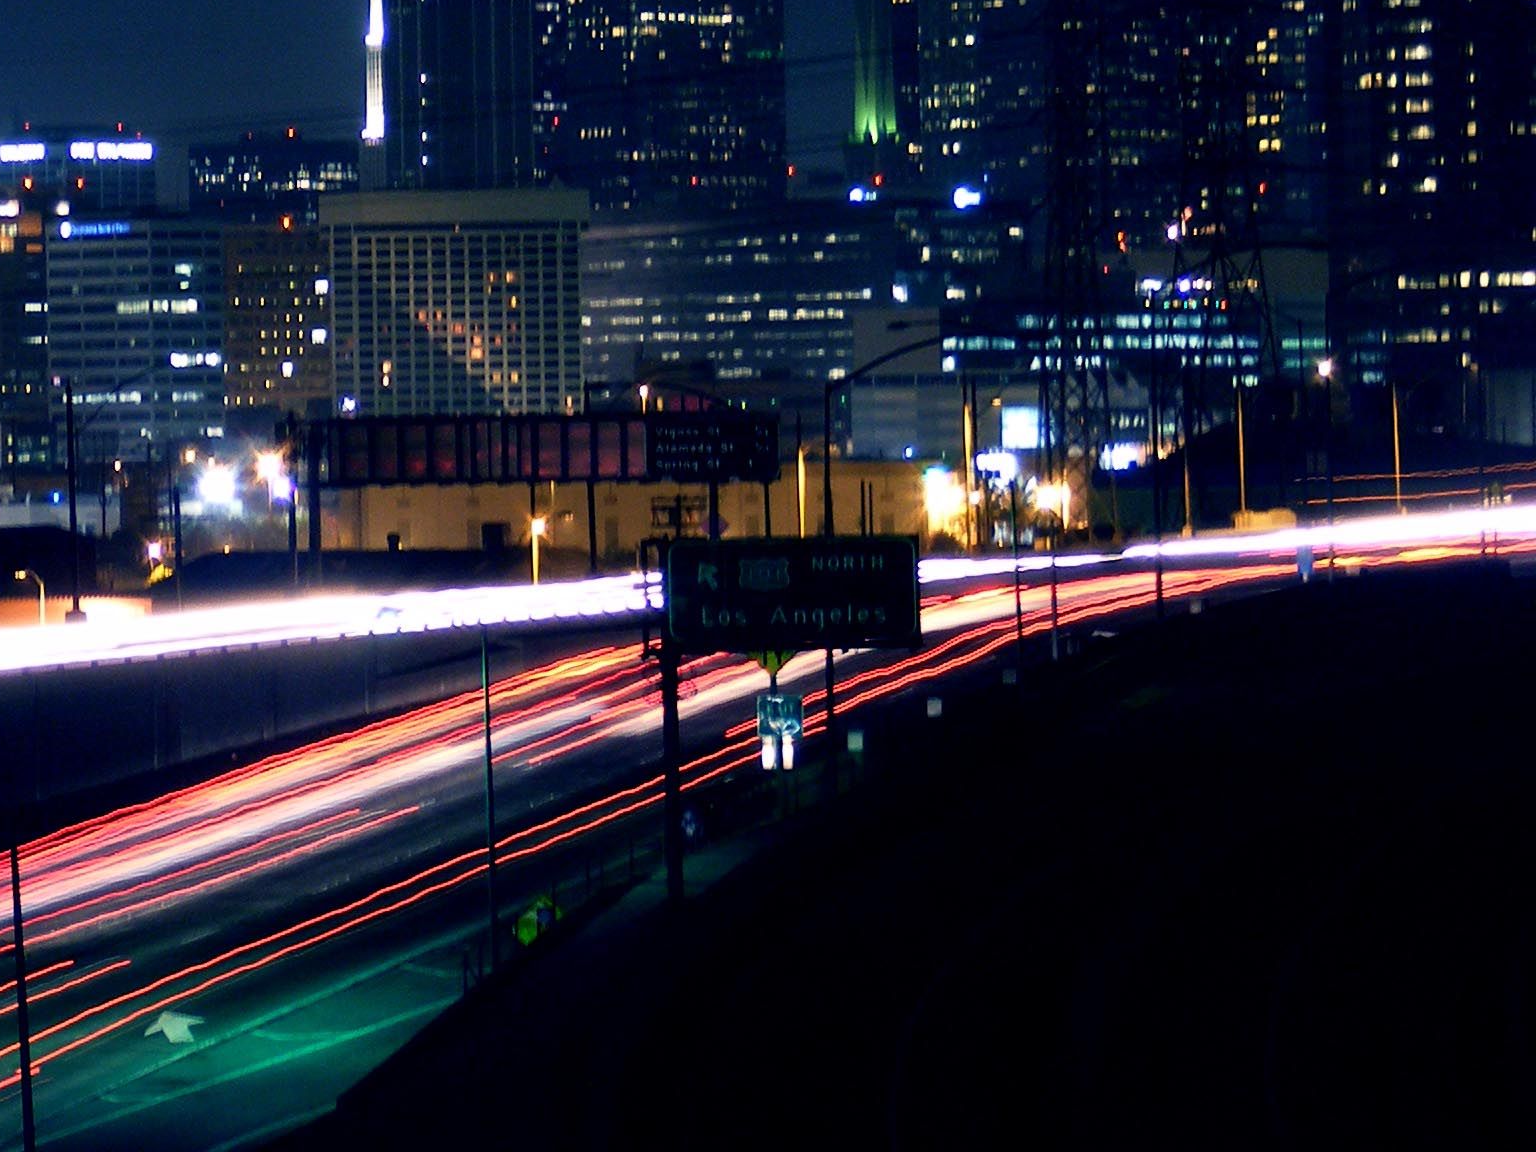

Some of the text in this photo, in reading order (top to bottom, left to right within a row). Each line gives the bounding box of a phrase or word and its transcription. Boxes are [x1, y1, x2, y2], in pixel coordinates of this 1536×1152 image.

[811, 552, 886, 572] NORTH
[701, 602, 888, 632] Los Angeles
